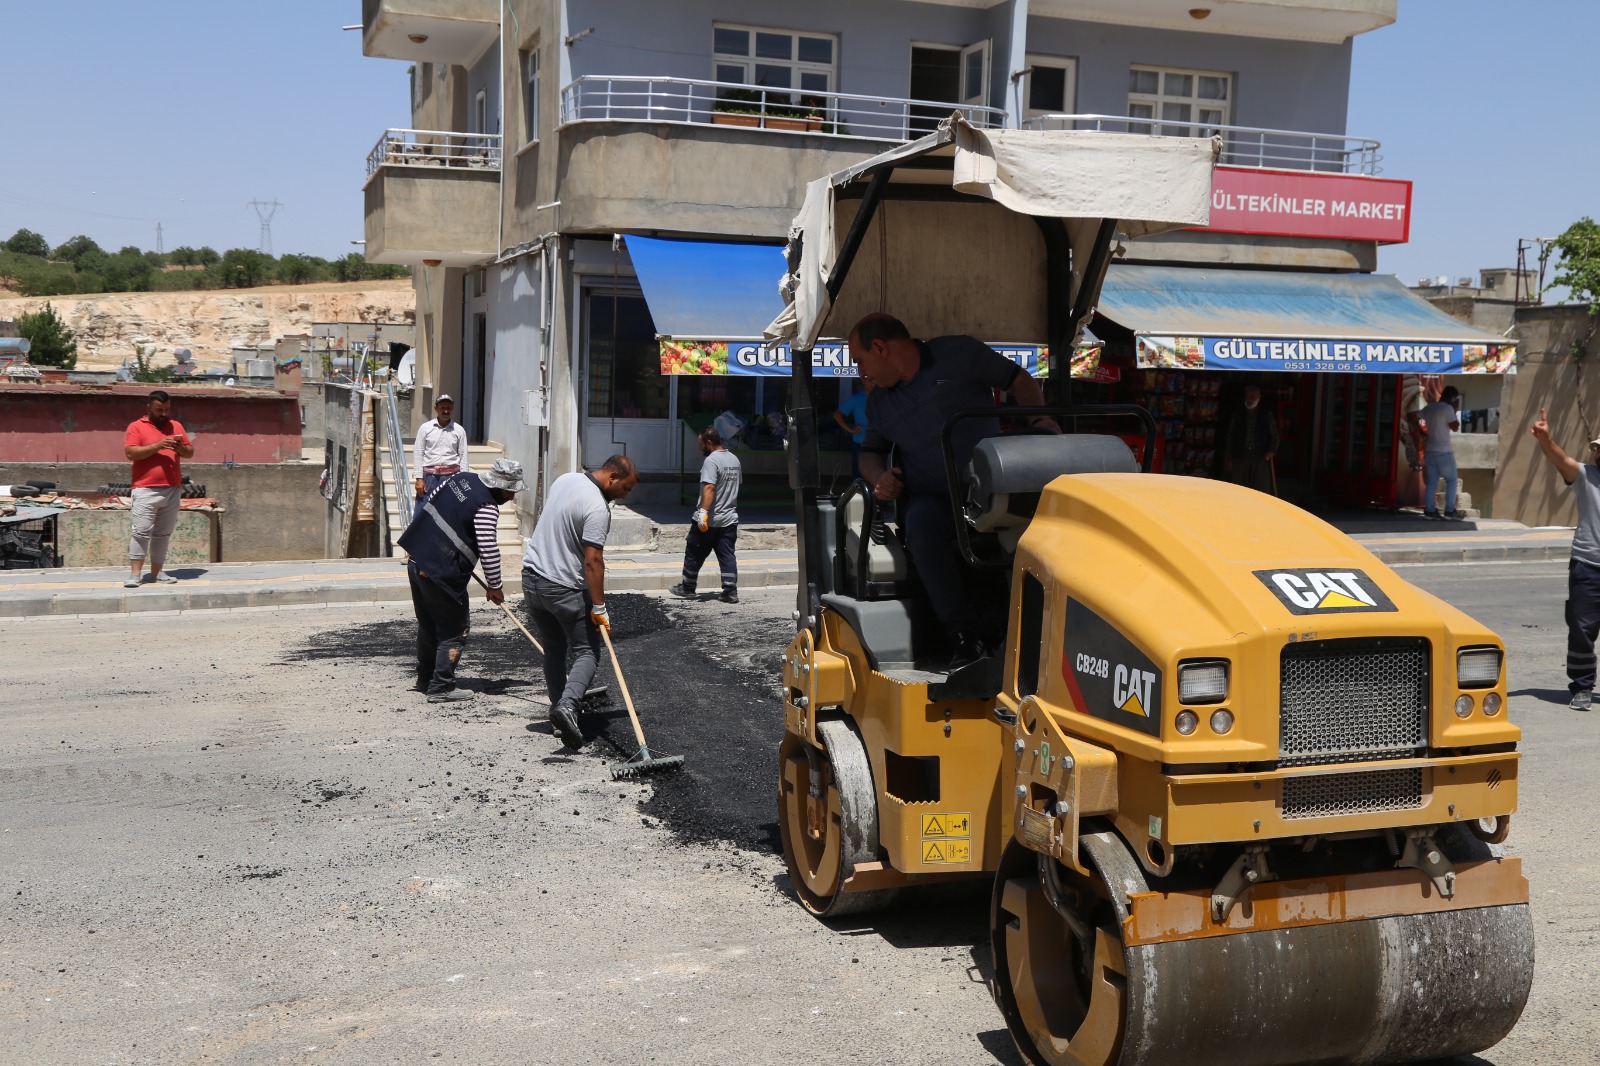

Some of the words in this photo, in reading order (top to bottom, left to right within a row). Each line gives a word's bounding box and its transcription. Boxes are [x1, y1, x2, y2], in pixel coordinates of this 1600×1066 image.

[1210, 189, 1326, 216] ÜLTEKİNLER
[1331, 200, 1406, 221] MARKET
[1213, 338, 1362, 363] GÜLTEKİNLER
[1366, 343, 1454, 364] MARKET
[1284, 362, 1310, 371] 0531
[1313, 363, 1335, 371] 328
[1271, 571, 1378, 609] CAT
[1076, 652, 1109, 680] CB24B
[1113, 663, 1156, 718] CAT
